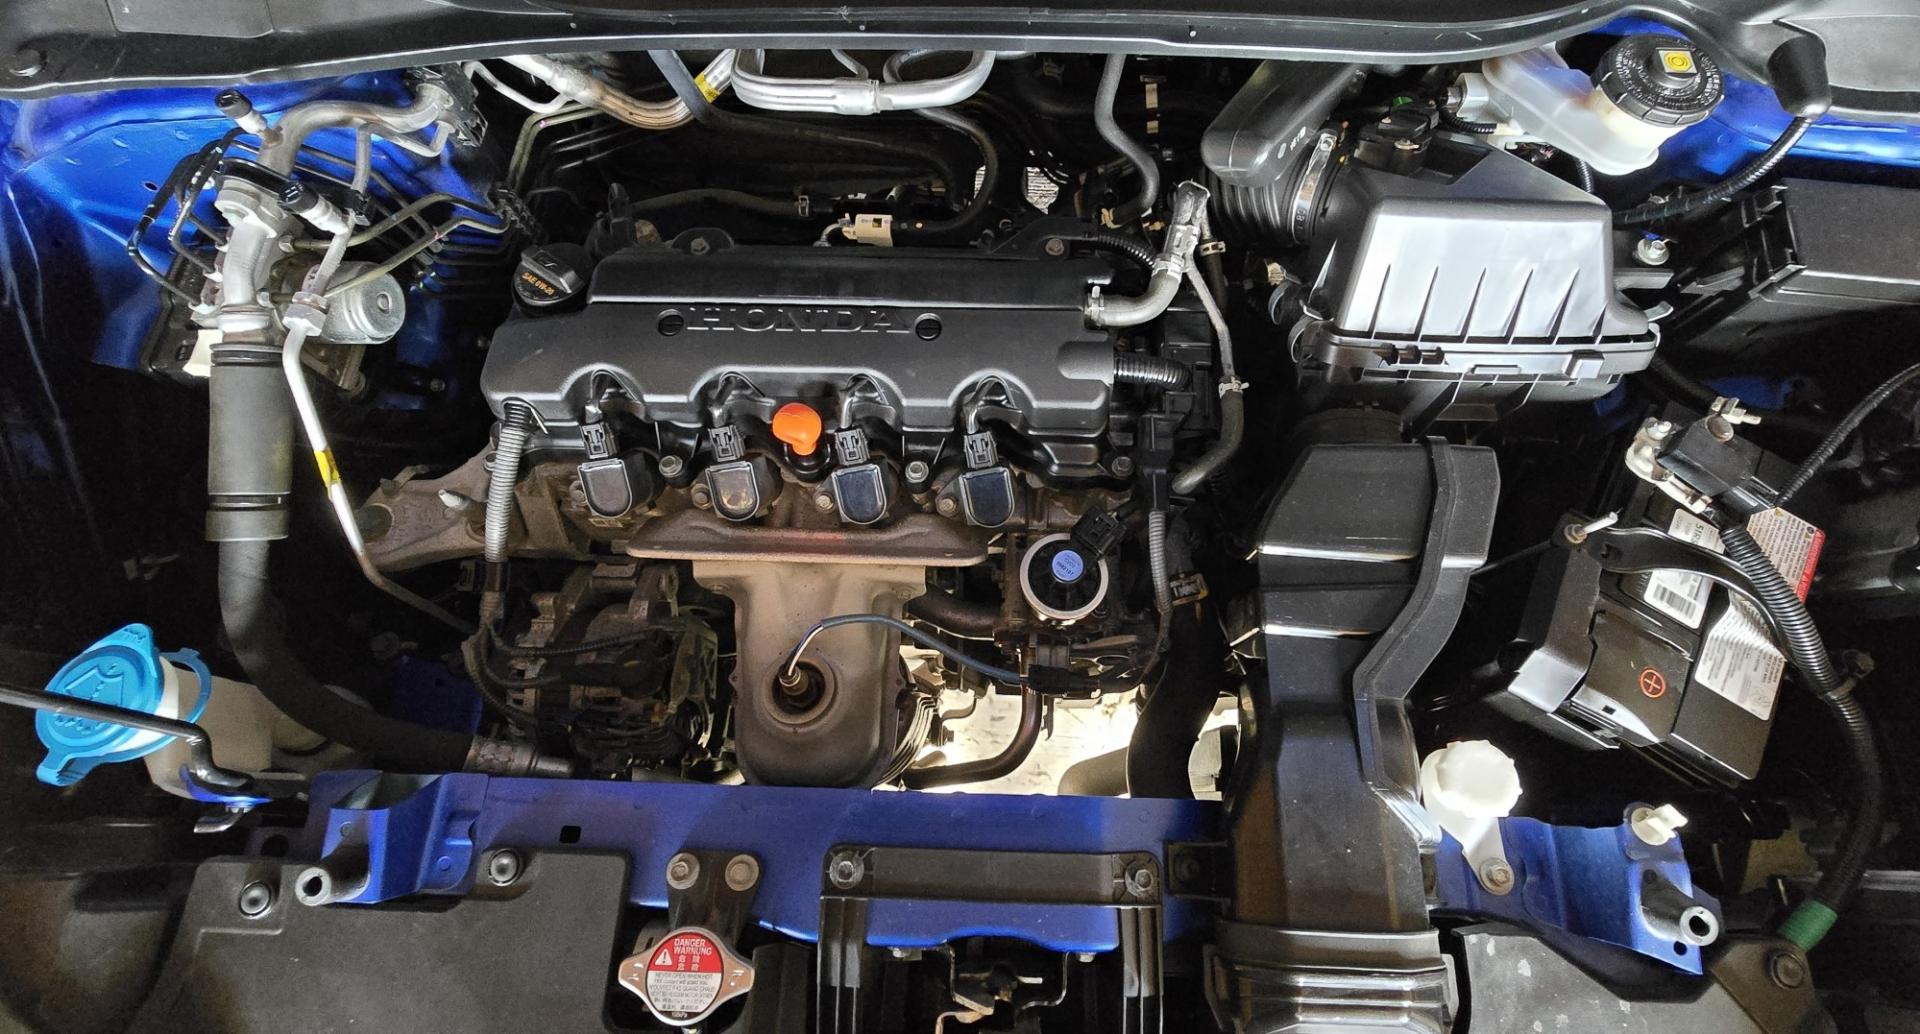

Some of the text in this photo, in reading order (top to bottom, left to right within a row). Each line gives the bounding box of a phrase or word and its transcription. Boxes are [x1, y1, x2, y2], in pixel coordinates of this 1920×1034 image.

[522, 272, 538, 284] SAE
[687, 307, 910, 334] HONDA
[674, 938, 706, 947] DANGER
